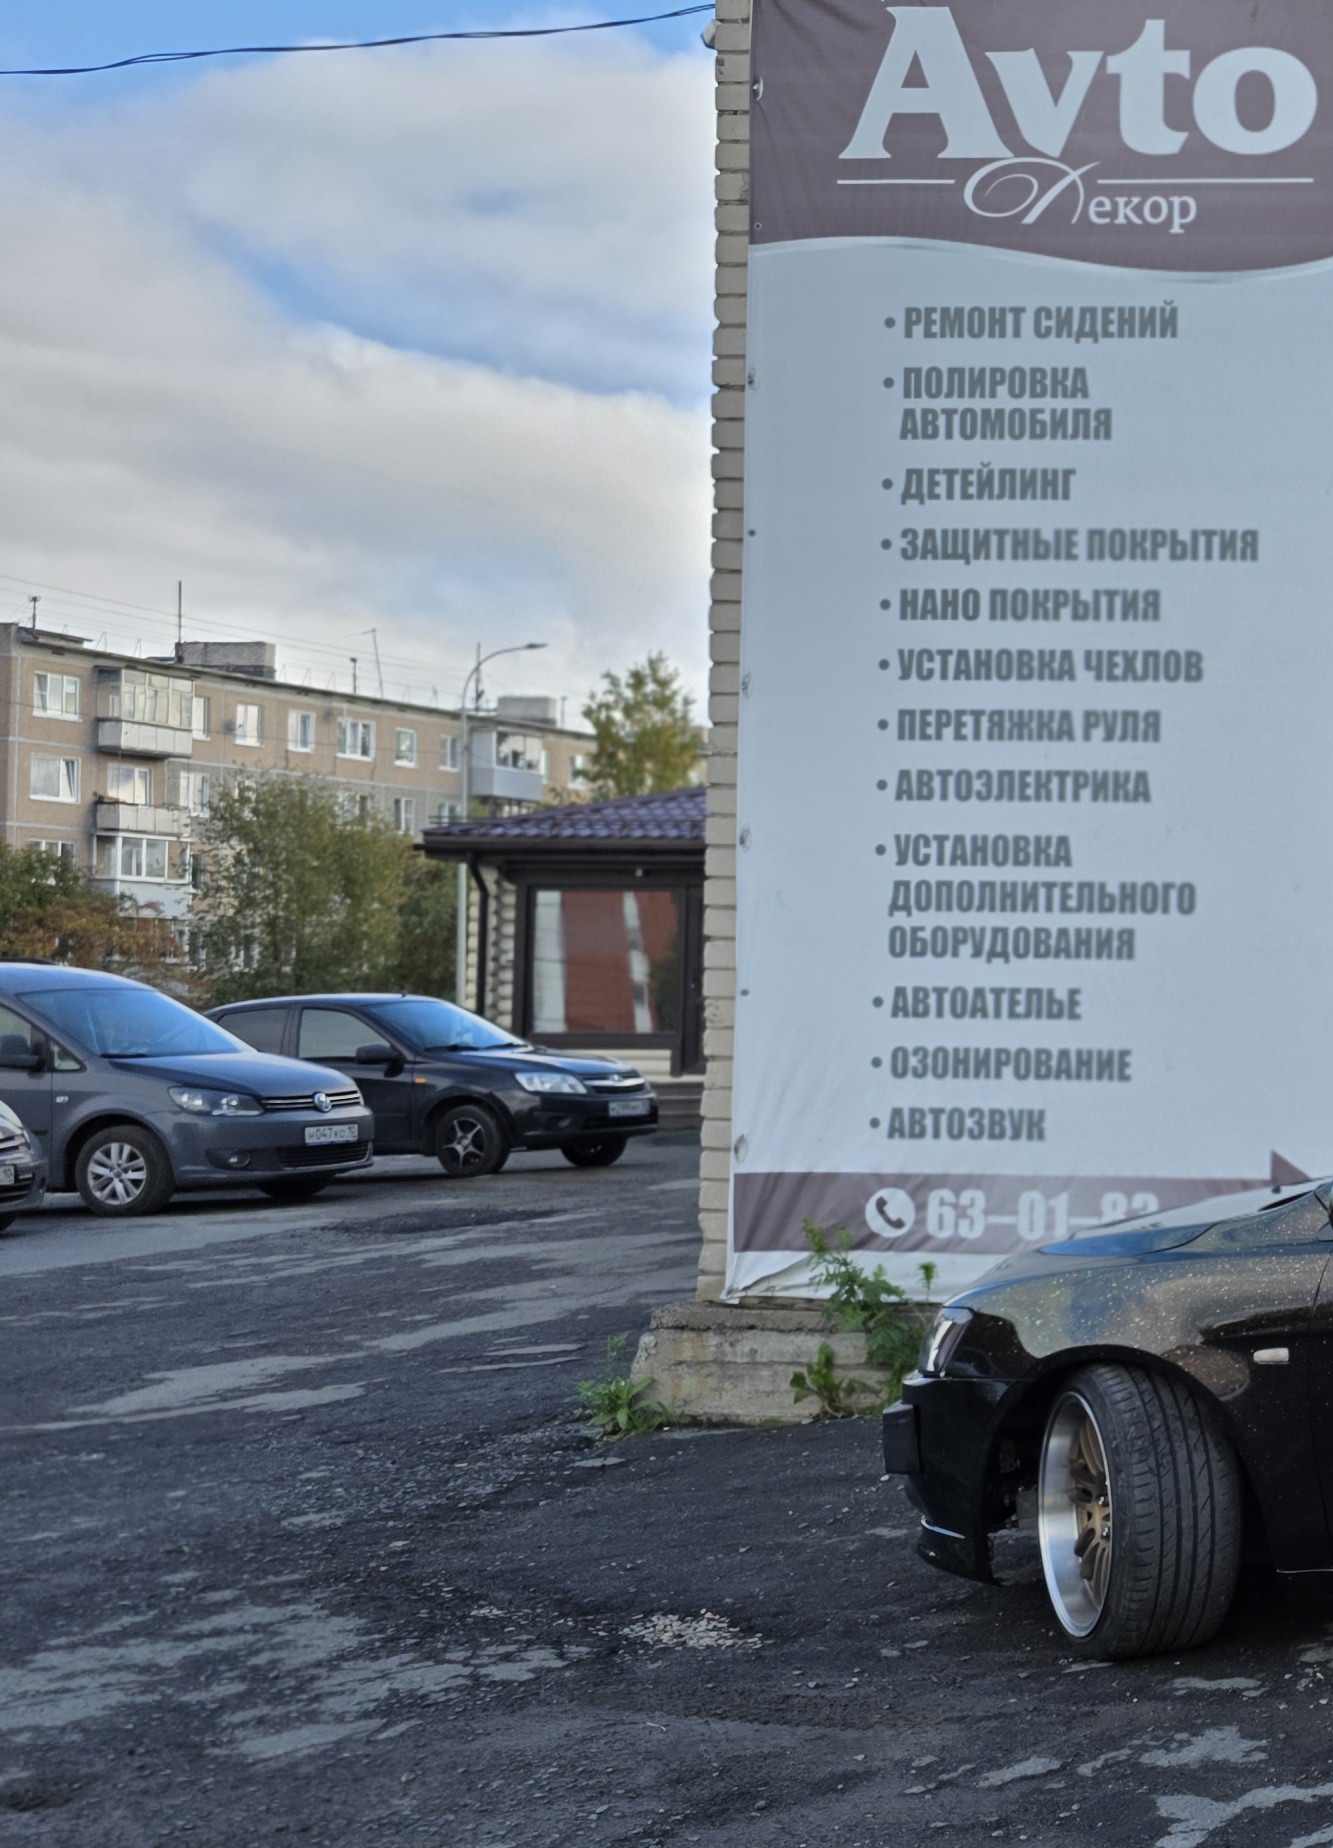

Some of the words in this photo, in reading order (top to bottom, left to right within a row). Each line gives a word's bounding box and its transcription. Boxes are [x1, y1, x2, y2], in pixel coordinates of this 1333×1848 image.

[838, 6, 1318, 159] Avto
[963, 157, 1198, 233] Декор
[904, 306, 1026, 339] РЕМОНТ
[1034, 300, 1178, 344] СИДЕНИЙ
[903, 366, 1089, 399] ПОЛИРОВКА
[900, 408, 1112, 440] АВТОМОБИЛЯ
[901, 462, 1076, 505] ДЕТЕЙЛИНГ
[901, 528, 1078, 565] ЗАЩИТНЫЕ
[1087, 528, 1258, 561] ПОКРЫТИЯ
[900, 588, 980, 621] НАНО
[989, 588, 1160, 621] ПОКРЫТИЯ
[898, 649, 1076, 681] УСТАНОВКА
[1084, 650, 1203, 682] ЧЕХЛОВ
[898, 709, 1075, 742] ПЕРЕТЯЖКА
[1083, 710, 1160, 742] РУЛЯ
[895, 769, 1151, 803] АВТОЭЛЕКТРИКА
[894, 834, 1072, 867] УСТАНОВКА
[888, 880, 1196, 917] ДОПОЛНИТЕЛЬНОГО
[889, 926, 1135, 964] ОБОРУДОВАНИЯ
[891, 986, 1081, 1020] АВТОАТЕЛЬЕ
[891, 1046, 1131, 1082] ОЗОНИРОВАНИЕ
[887, 1108, 1045, 1141] АВТОЗВУК
